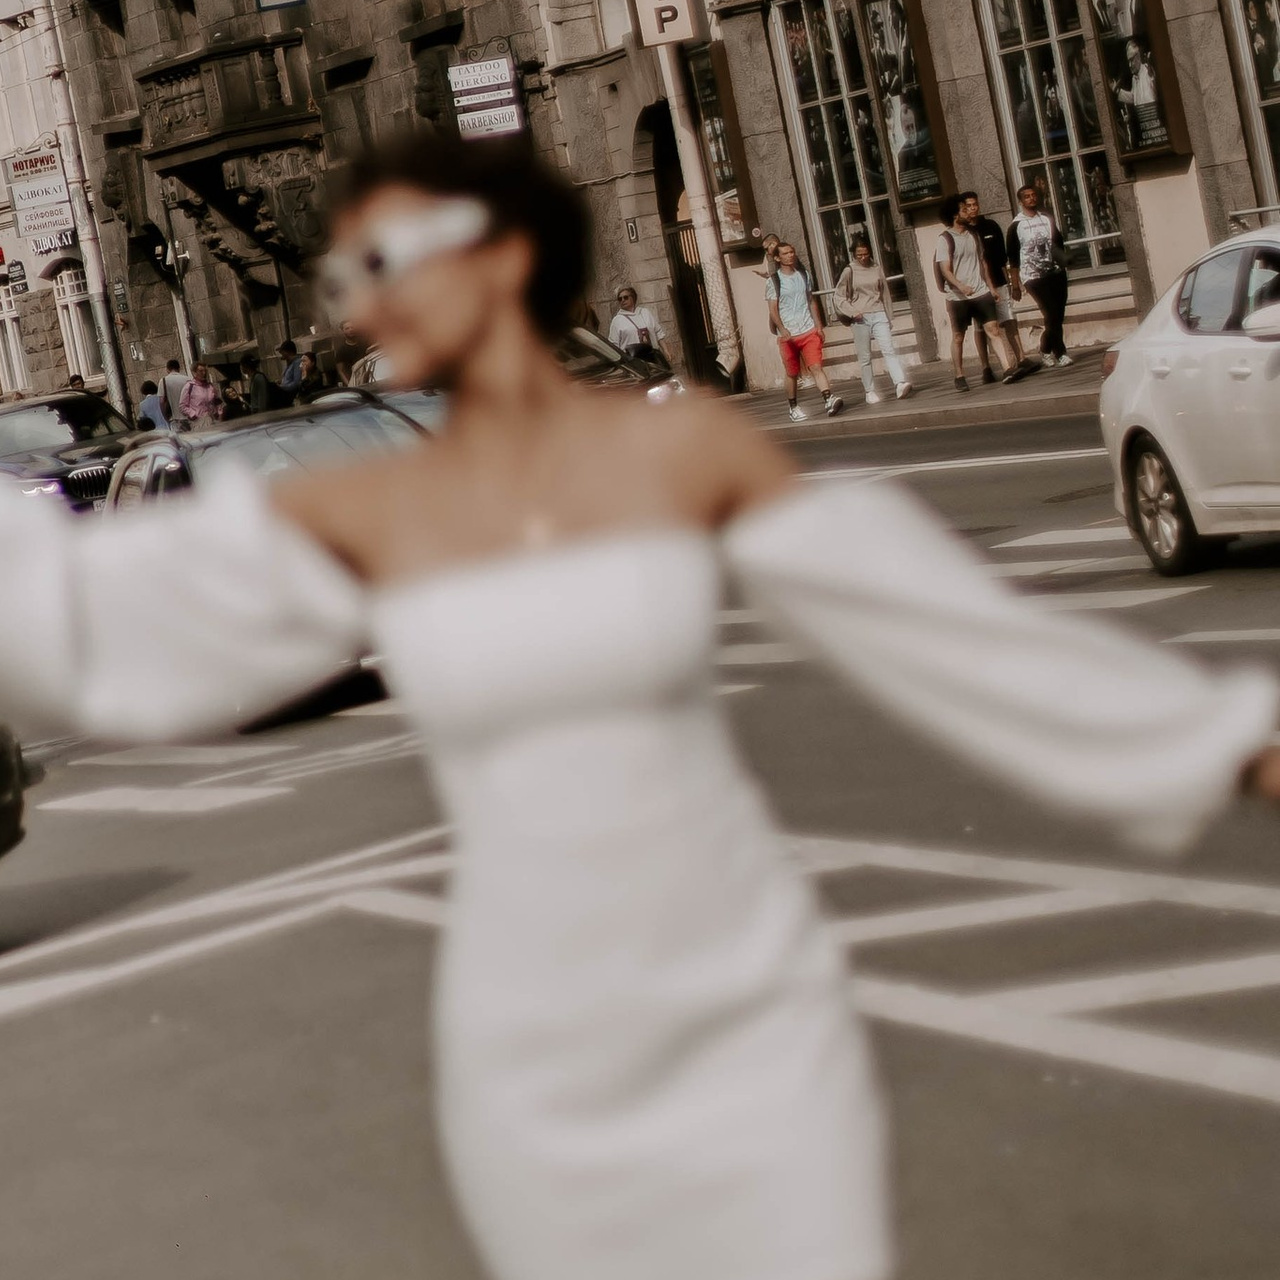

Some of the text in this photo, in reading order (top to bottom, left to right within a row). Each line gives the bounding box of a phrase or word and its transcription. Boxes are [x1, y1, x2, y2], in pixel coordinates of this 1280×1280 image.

[456, 61, 500, 76] TATTOO
[453, 73, 507, 89] PIERCING
[460, 111, 515, 131] BARBERSHOP
[12, 154, 56, 172] НОТАРИУС
[18, 185, 63, 202] АДВОКАТ
[25, 207, 64, 222] СЕЙФОВОЕ
[23, 217, 70, 233] ХРАНИЛИЩЕ
[32, 231, 73, 254] АДВОКАТ
